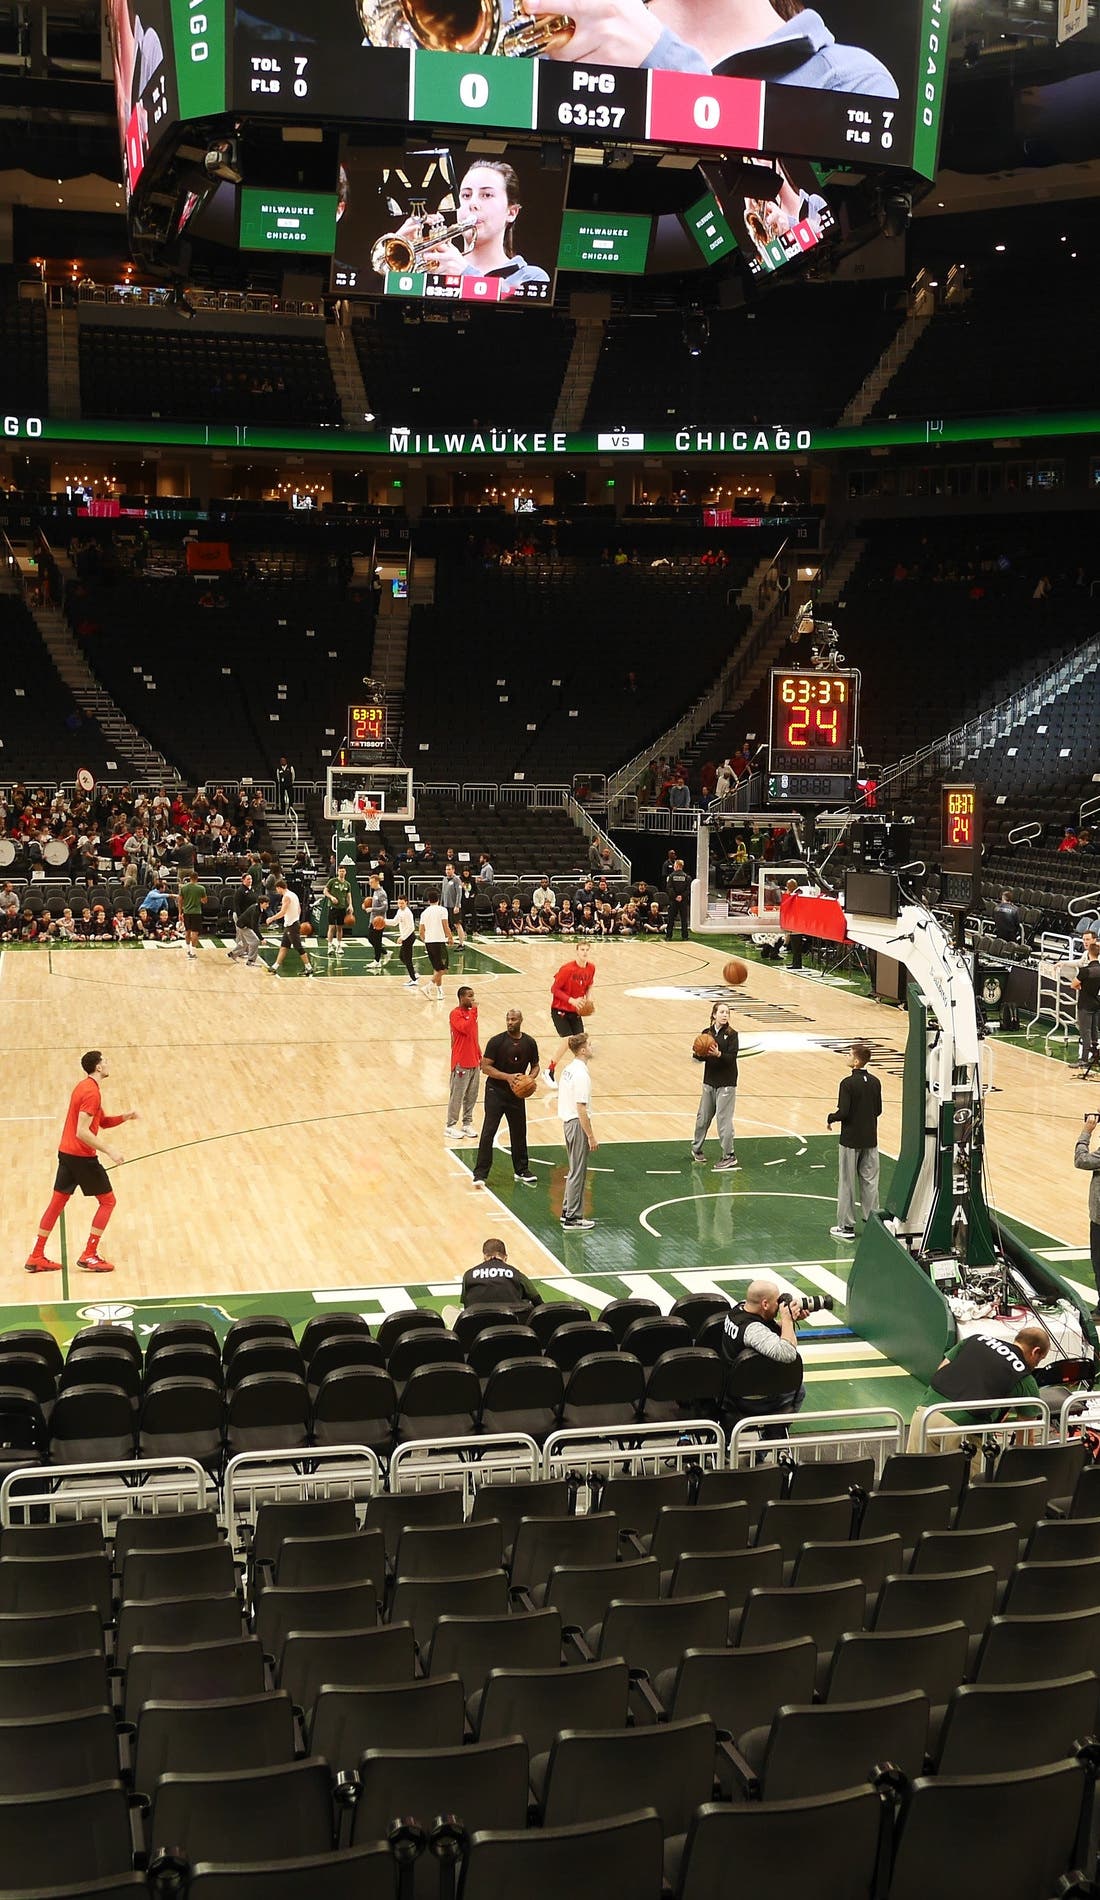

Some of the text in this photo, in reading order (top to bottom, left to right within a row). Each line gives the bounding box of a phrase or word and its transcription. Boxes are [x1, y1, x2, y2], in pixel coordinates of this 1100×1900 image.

[250, 57, 308, 75] TOL 7
[251, 78, 308, 97] FLS 0
[459, 73, 489, 109] 0
[572, 71, 615, 94] PrG
[557, 102, 626, 129] 63:37
[693, 96, 721, 130] 0
[847, 109, 894, 129] TOL 7
[846, 130, 893, 149] FLS 0
[261, 205, 315, 216] MILWAUKEE
[266, 231, 307, 241] CHICAGO
[579, 227, 629, 237] MILWAUKEE
[581, 252, 620, 261] CHICAGO
[399, 277, 413, 291] 0
[474, 281, 488, 296] 0
[4, 416, 42, 437] GO
[389, 430, 812, 453] MILWAUKEE VS CHICAGO
[783, 679, 845, 704] 63:37
[353, 709, 383, 721] 63:37
[355, 720, 380, 738] 24
[788, 706, 837, 746] 24
[949, 793, 974, 815] 63:37
[952, 816, 969, 843] 24
[472, 1267, 514, 1279] PHOTO
[977, 1335, 1026, 1373] PHOTO
